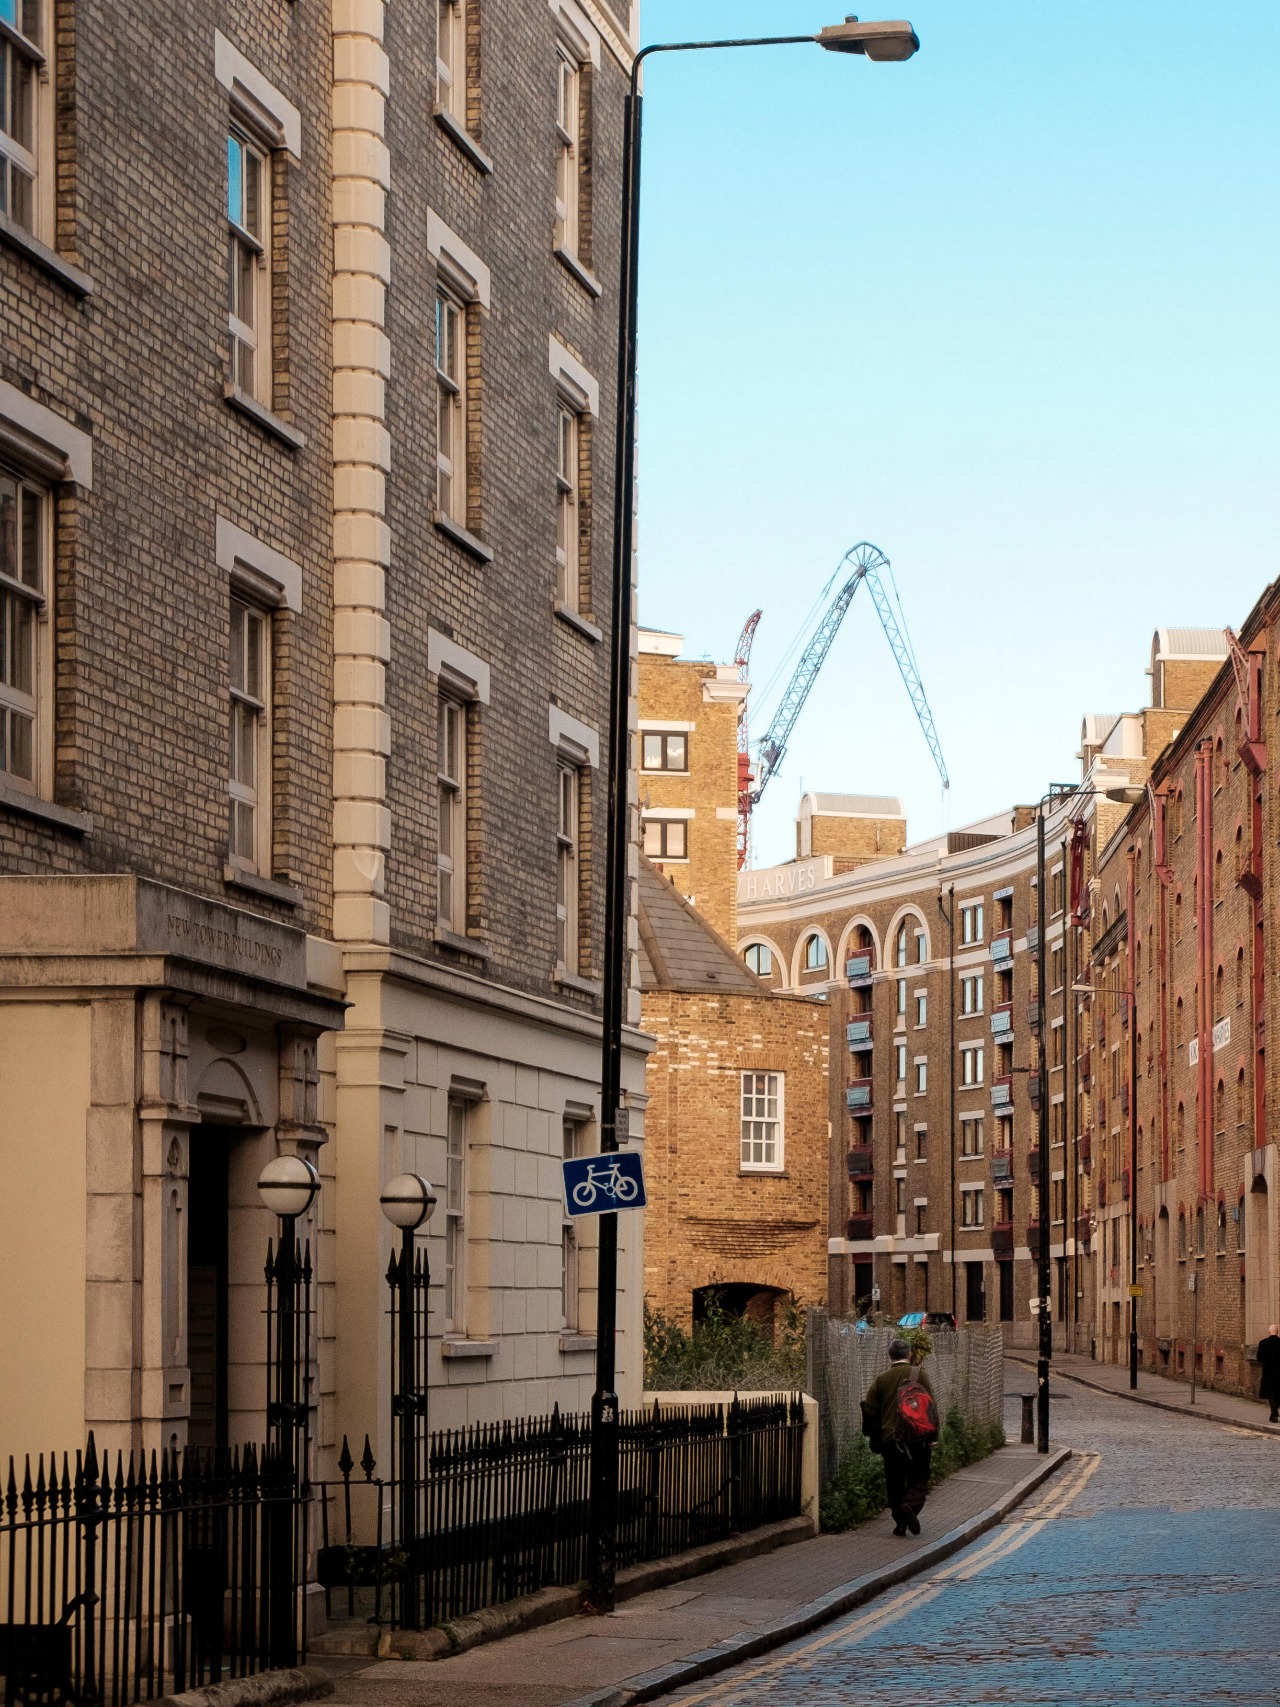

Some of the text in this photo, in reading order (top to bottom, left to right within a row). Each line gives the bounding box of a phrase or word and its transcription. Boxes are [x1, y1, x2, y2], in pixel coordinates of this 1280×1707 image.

[167, 914, 282, 967] NEW TOWER BUILDINGS
